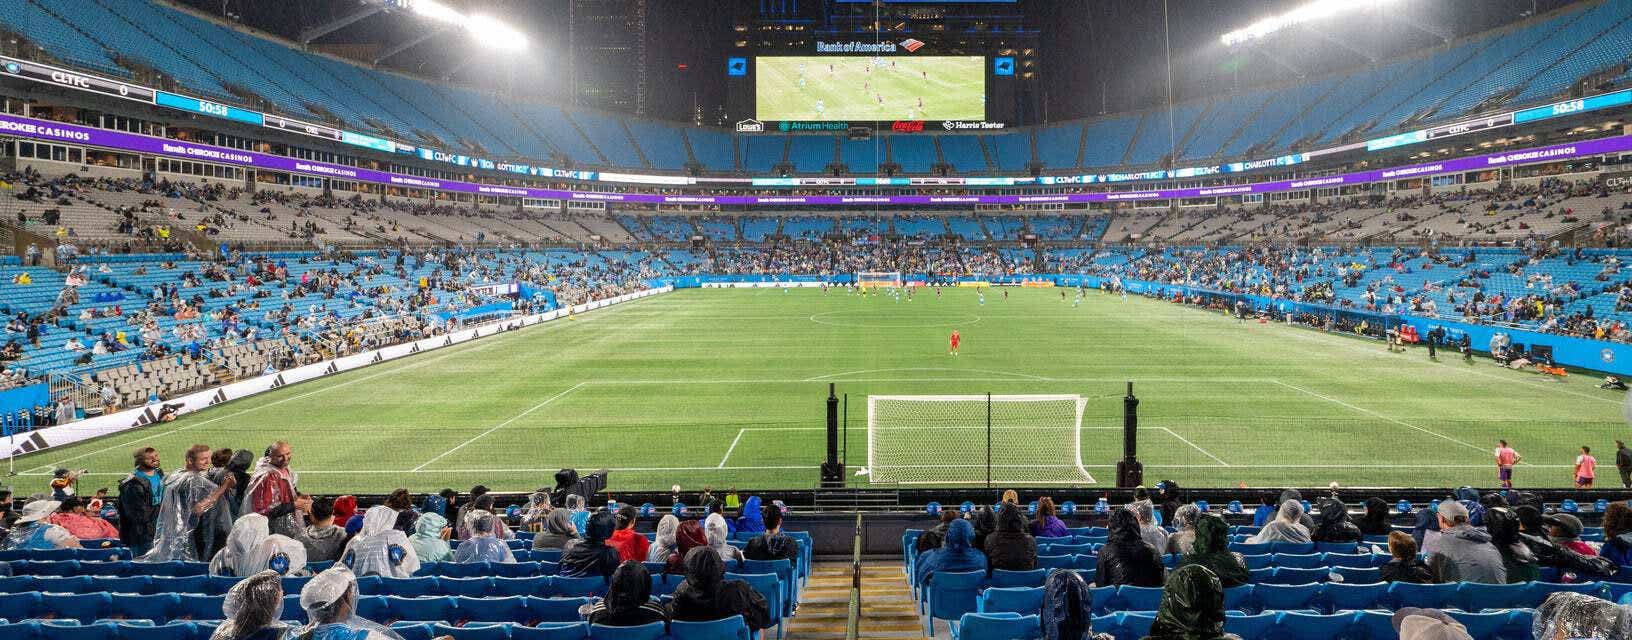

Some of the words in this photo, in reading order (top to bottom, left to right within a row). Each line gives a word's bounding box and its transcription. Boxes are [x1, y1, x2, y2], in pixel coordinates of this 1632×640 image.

[816, 41, 843, 52] Bank
[844, 41, 855, 52] of
[855, 41, 897, 52] America
[119, 84, 129, 96] 0
[199, 101, 228, 116] 50:58
[1552, 100, 1585, 116] 50:58
[279, 119, 286, 128] 0
[791, 121, 821, 129] Atrium
[821, 121, 849, 129] Health
[955, 121, 980, 129] Harris
[980, 121, 1005, 129] Teeter
[1487, 119, 1495, 127] 0
[37, 126, 90, 141] CASINOS
[220, 151, 253, 163] CASINOS
[1539, 146, 1577, 158] CASINOS
